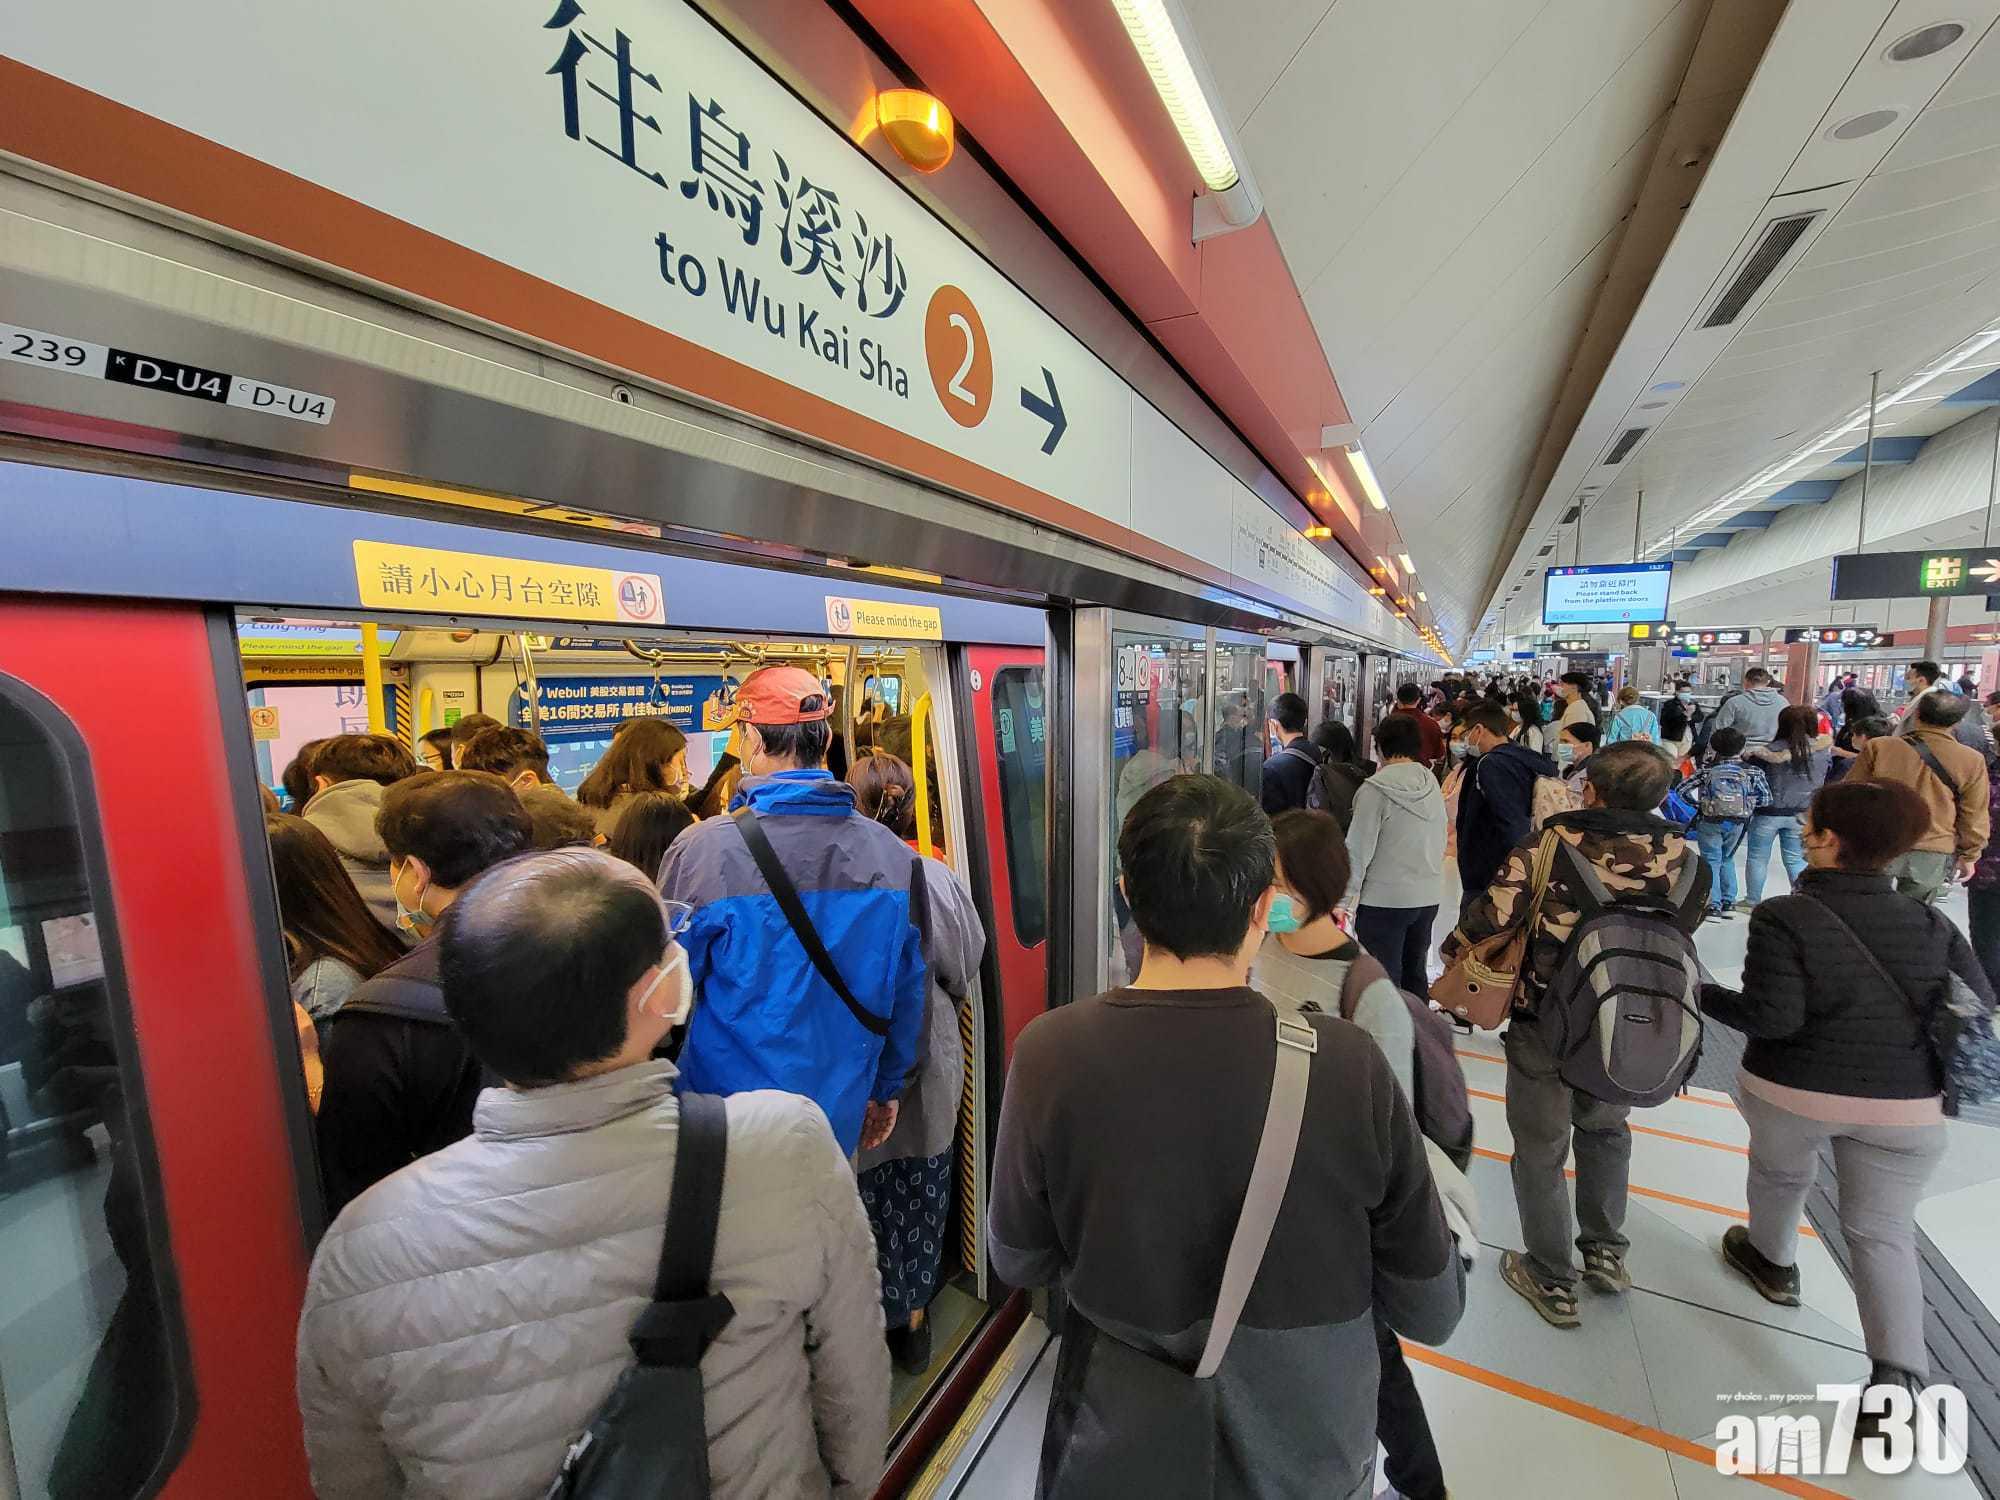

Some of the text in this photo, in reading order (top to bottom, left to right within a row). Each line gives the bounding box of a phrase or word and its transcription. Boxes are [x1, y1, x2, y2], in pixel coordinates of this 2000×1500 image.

[543, 0, 907, 318] 往烏溪沙
[654, 231, 909, 399] to Wu Kai Sha
[947, 312, 977, 406] 2
[133, 360, 222, 398] D-U4
[252, 386, 326, 419] D-U4
[379, 561, 601, 608] 請小心月台空隙
[1926, 578, 1960, 588] EXIT
[1928, 557, 1962, 579] 出
[856, 610, 938, 631] Please mind the gap
[1119, 655, 1134, 686] 8-4
[546, 686, 587, 699] Webull
